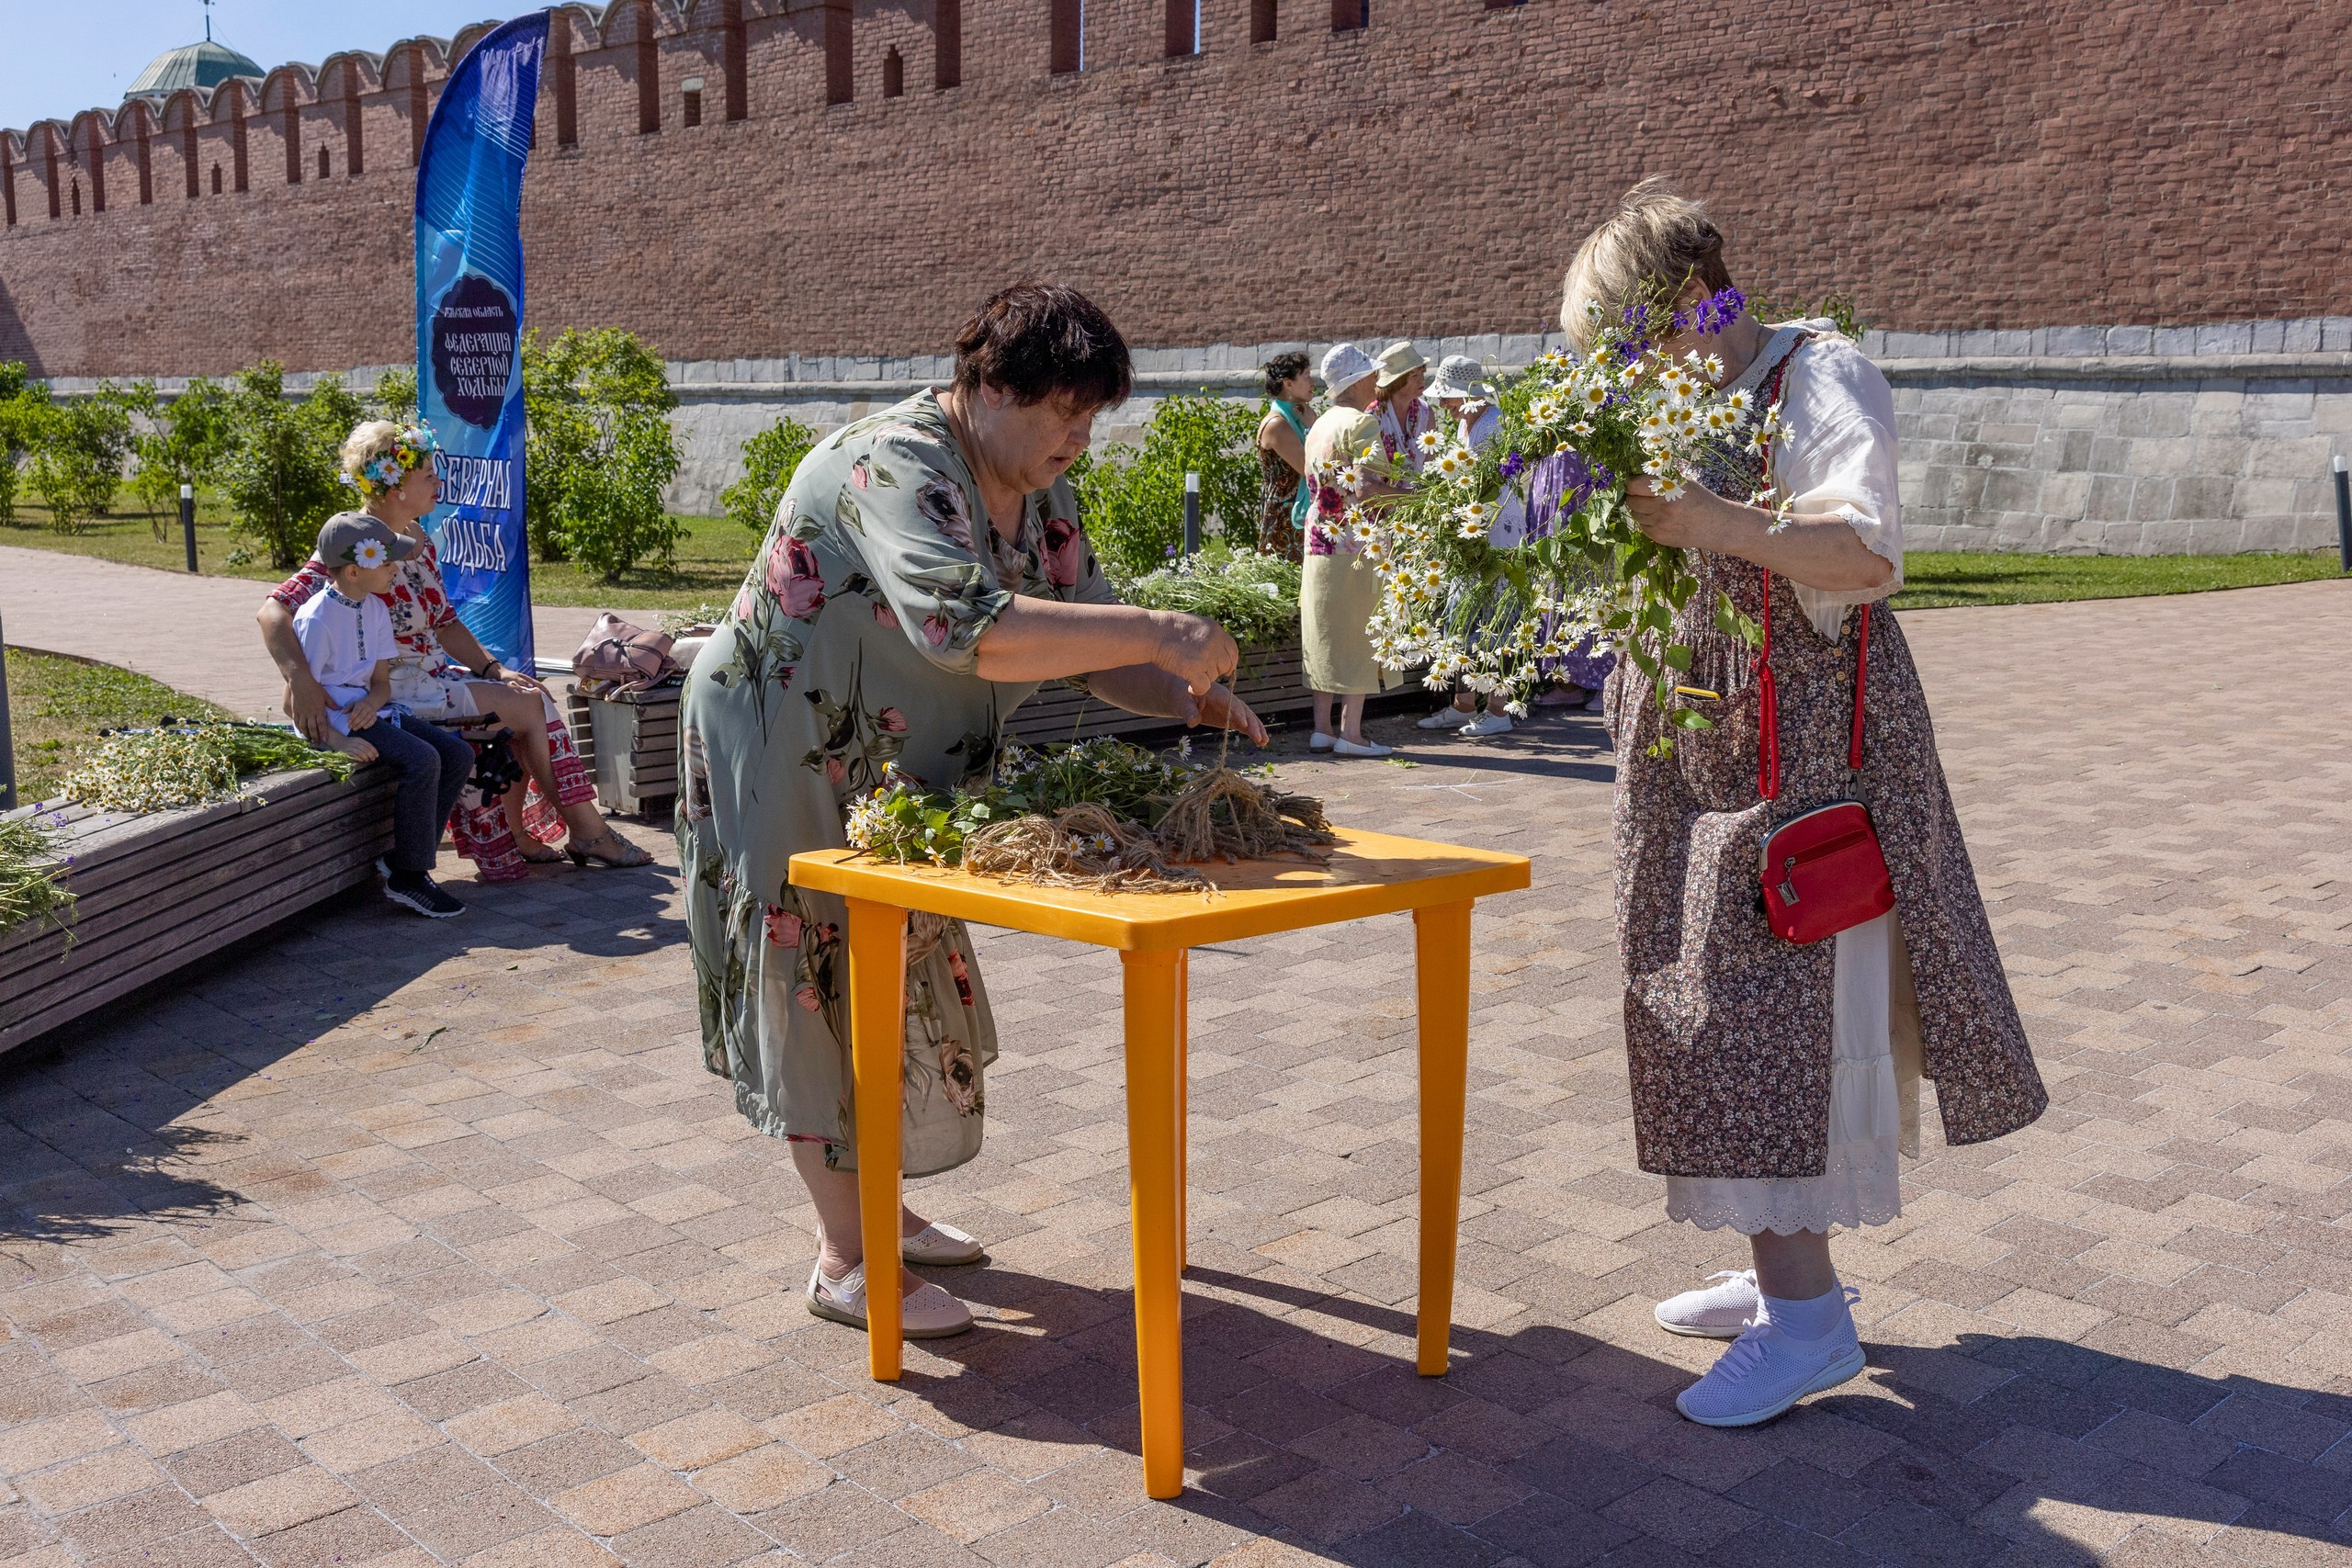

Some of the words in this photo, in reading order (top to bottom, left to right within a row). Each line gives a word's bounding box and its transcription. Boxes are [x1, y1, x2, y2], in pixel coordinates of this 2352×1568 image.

[472, 306, 503, 318] ОБЛАСТЬ
[445, 332, 512, 355] ФЕДЕРАЦИЯ
[450, 353, 509, 376] СЕВЕРНОЙ
[457, 377, 506, 400] ХОДЬБЫ
[441, 516, 507, 577] ХОДЬБА
